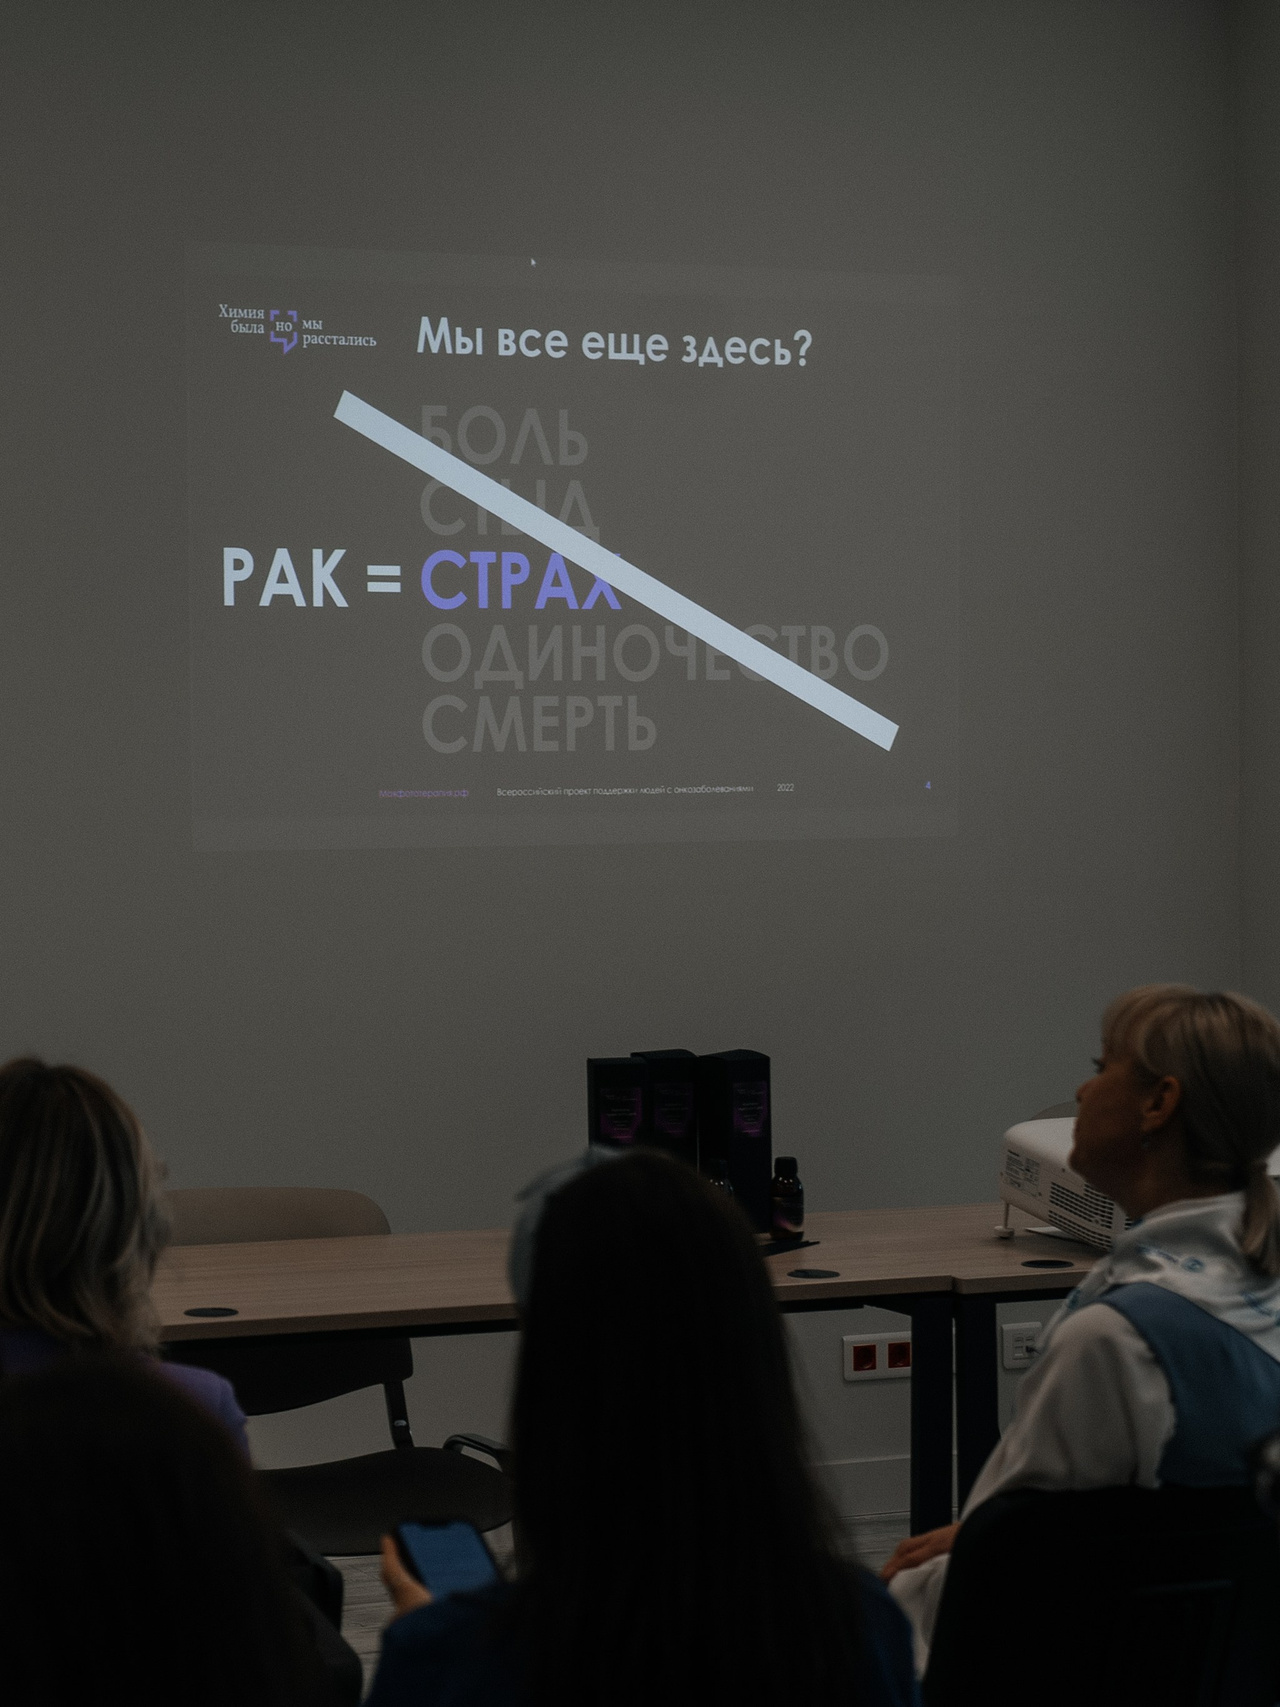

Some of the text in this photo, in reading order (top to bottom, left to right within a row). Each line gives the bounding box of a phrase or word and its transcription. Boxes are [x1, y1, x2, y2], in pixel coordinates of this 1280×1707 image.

[218, 304, 265, 319] Химия
[230, 319, 265, 334] была
[275, 321, 293, 332] но
[302, 319, 323, 330] мы
[302, 333, 377, 348] расстались
[416, 315, 813, 367] Мы все еще здесь?
[223, 547, 349, 607] РАК
[421, 694, 658, 754] СМЕРТЬ
[563, 787, 592, 797] проект
[593, 787, 637, 796] поддержки
[639, 785, 666, 795] людей
[776, 783, 795, 791] 2022
